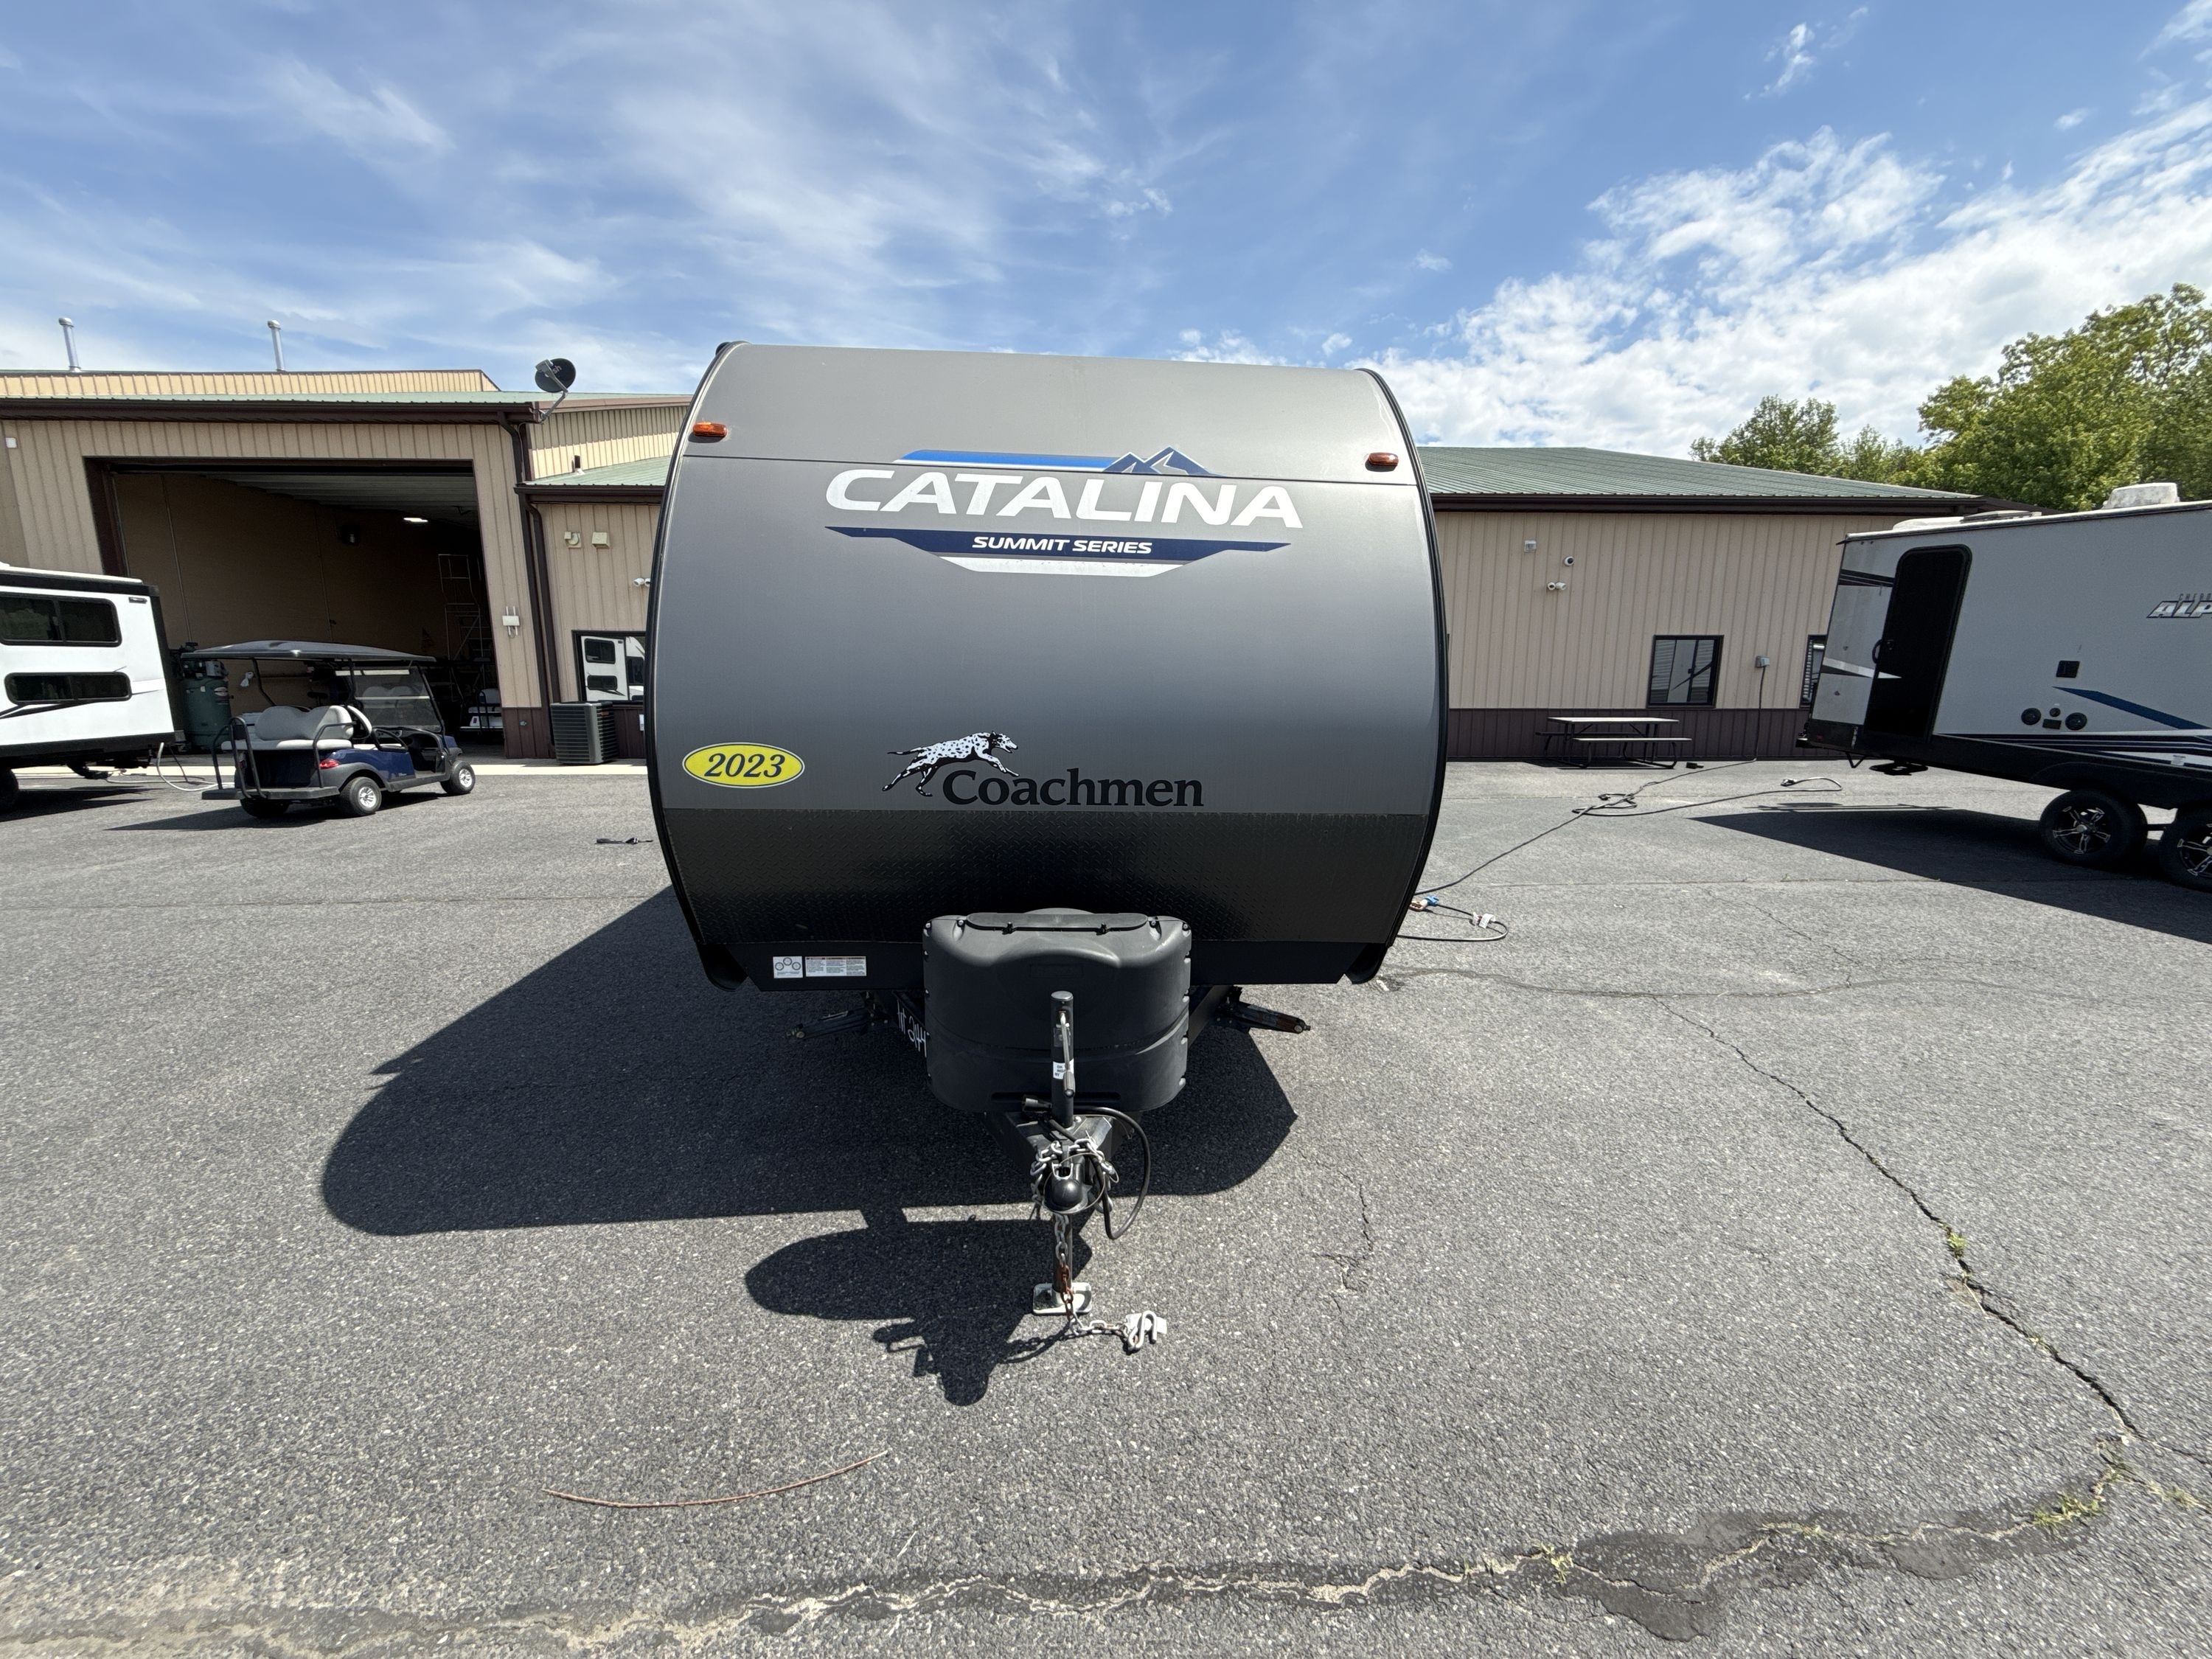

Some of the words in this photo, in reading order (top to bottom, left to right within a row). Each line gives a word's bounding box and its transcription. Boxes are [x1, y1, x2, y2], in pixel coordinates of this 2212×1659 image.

[826, 469, 1303, 529] CATALINA
[972, 536, 1070, 552] SUMMIT
[1072, 540, 1153, 554] SERIES
[703, 751, 787, 778] 2023
[942, 768, 1204, 807] Coachmen
